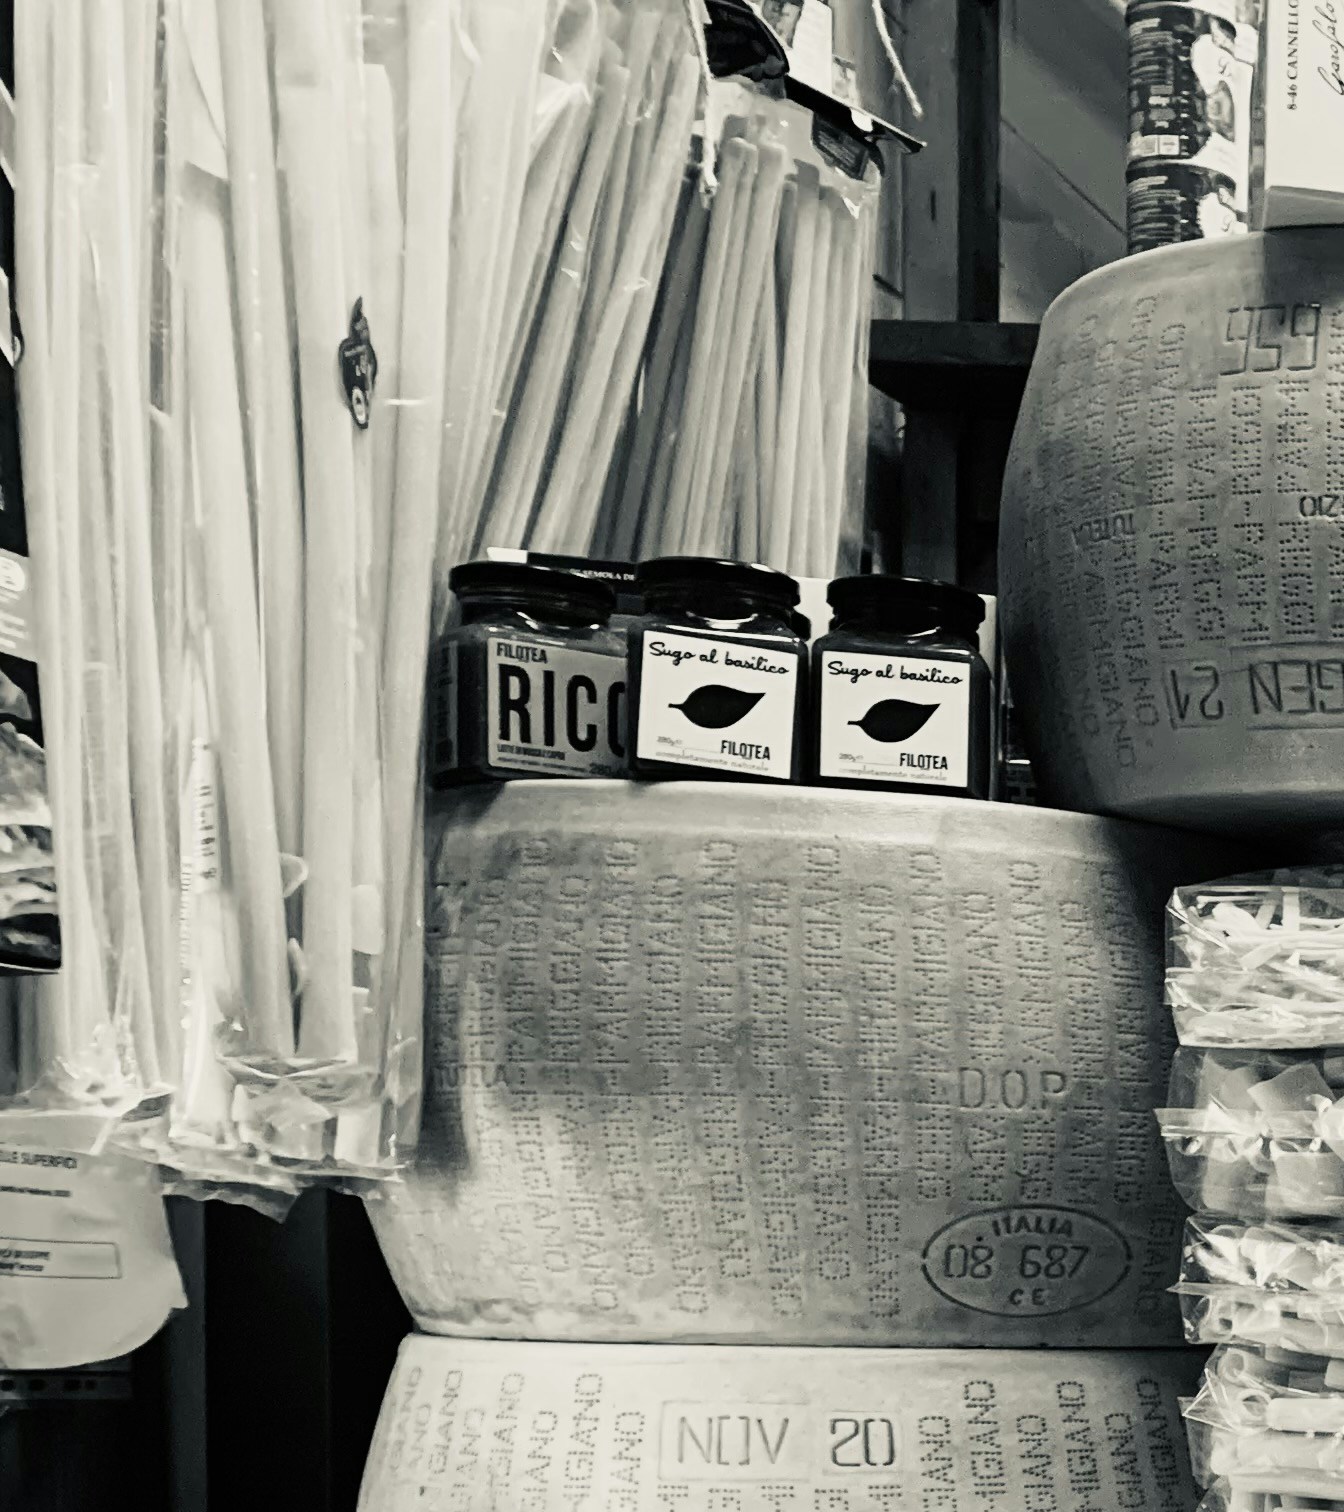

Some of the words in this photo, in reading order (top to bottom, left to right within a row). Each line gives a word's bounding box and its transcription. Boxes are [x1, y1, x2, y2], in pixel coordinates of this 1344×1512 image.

[648, 641, 696, 666] Sugo
[700, 649, 718, 663] al
[724, 649, 788, 675] basilico
[828, 660, 873, 684] Sugo
[876, 664, 893, 679] al
[900, 663, 962, 685] basilico
[720, 739, 771, 761] FILOTEA
[900, 752, 949, 770] FILOTEA
[993, 1217, 1074, 1240] ITALIA
[944, 1244, 994, 1280] 08
[1019, 1244, 1089, 1279] 687
[679, 1415, 790, 1467] NOV
[830, 1417, 896, 1467] 20
